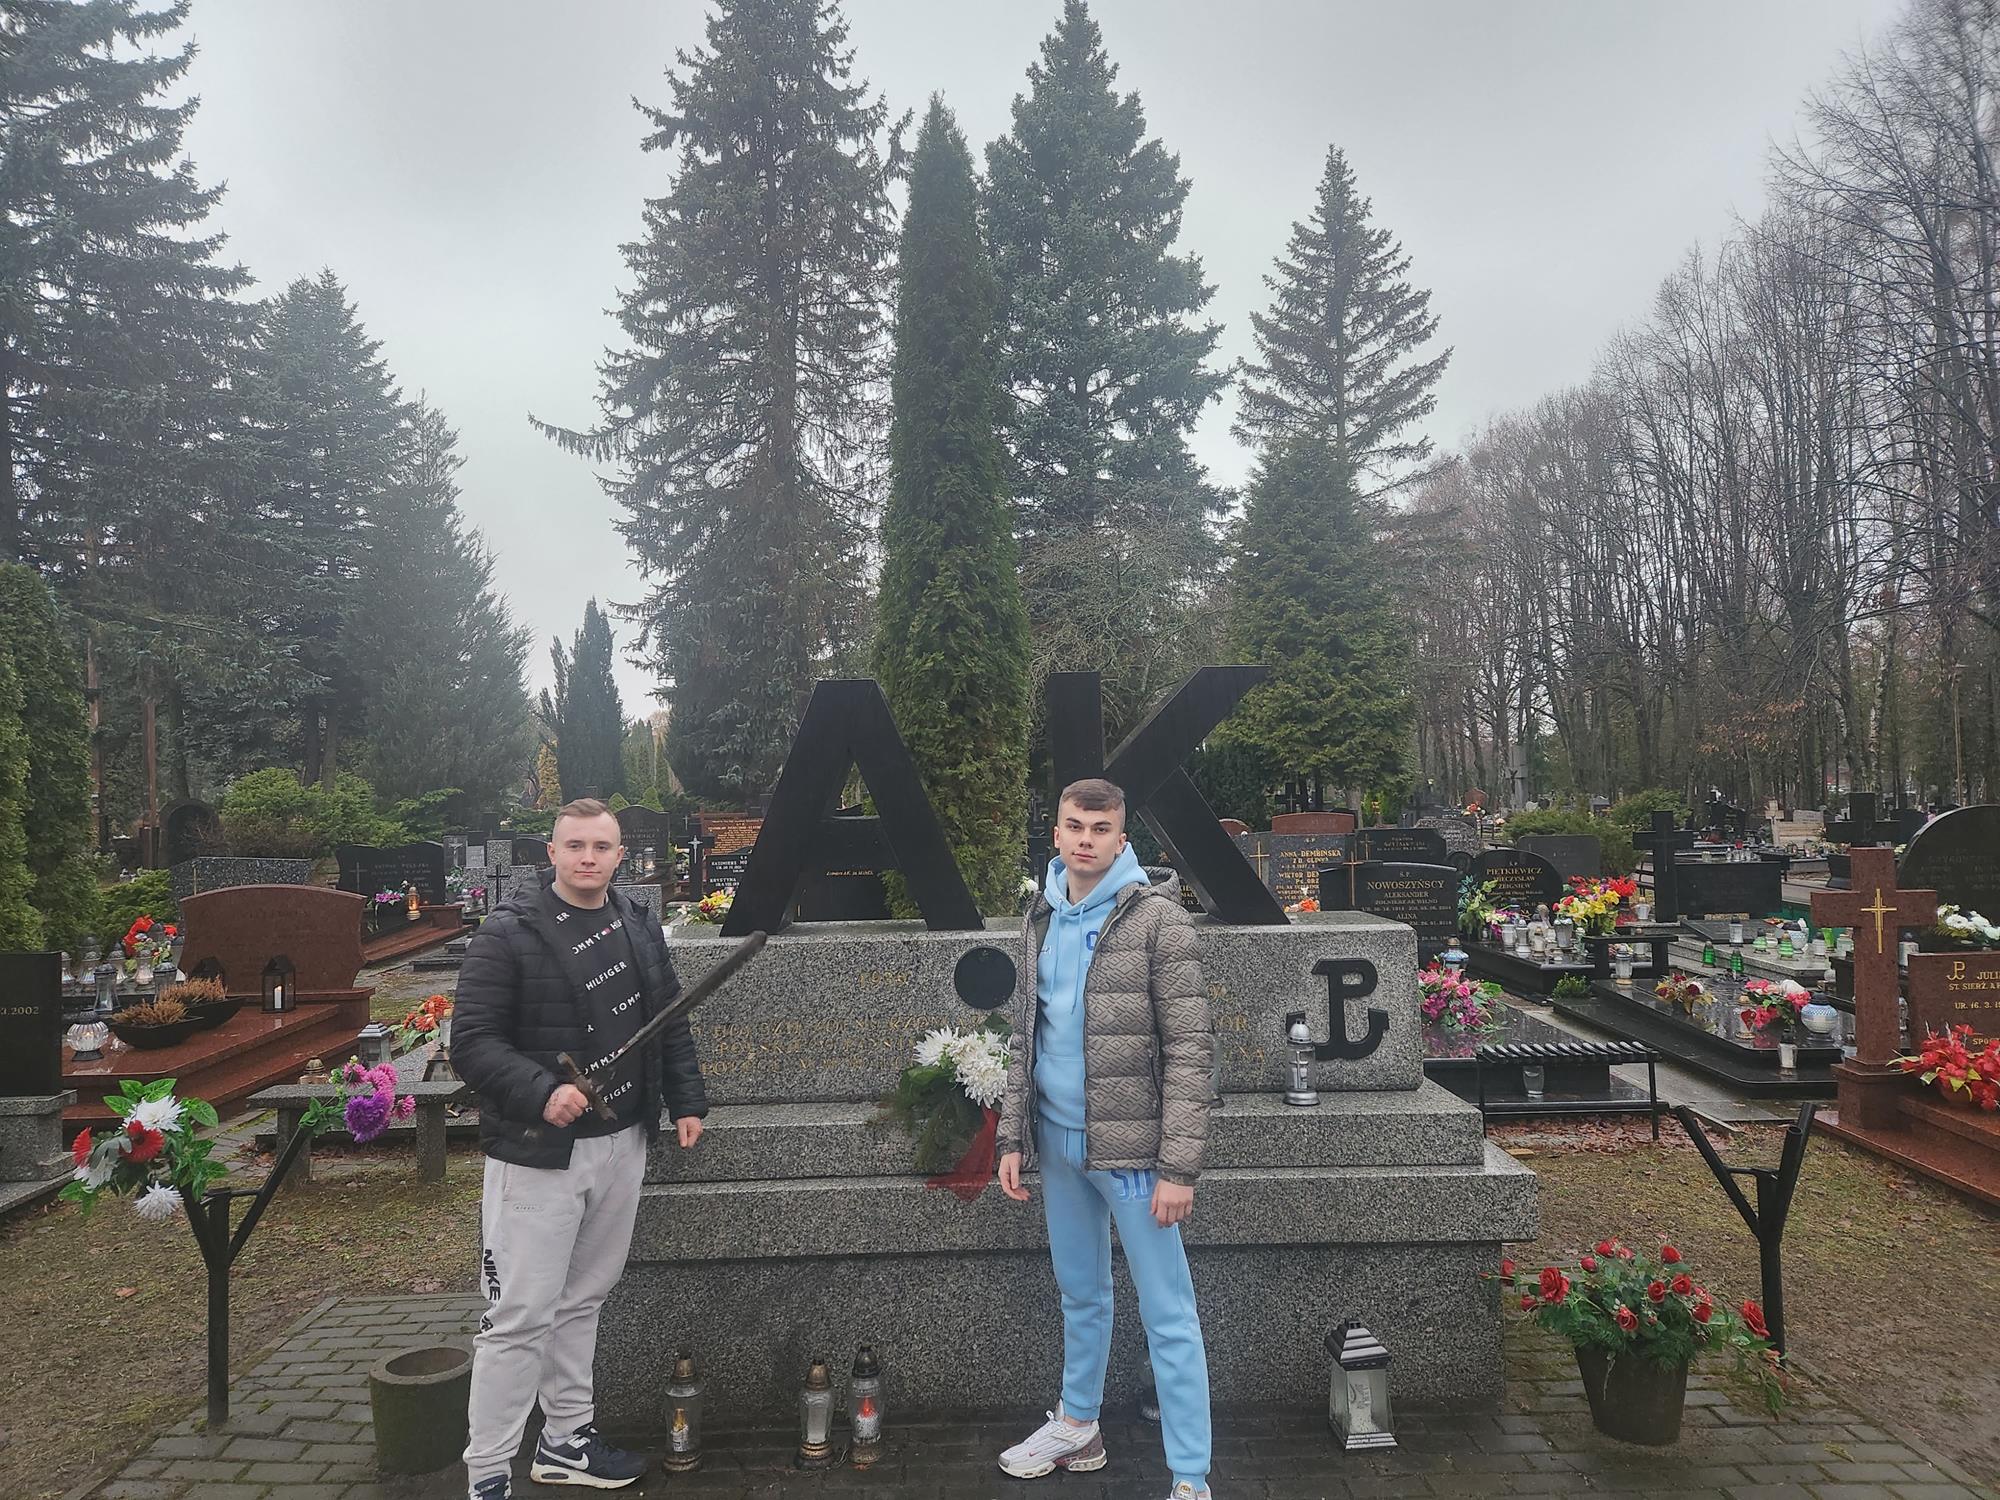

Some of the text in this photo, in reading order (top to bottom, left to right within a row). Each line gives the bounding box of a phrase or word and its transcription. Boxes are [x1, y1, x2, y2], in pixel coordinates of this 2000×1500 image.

[1367, 879, 1445, 890] NOWOSZYŃSCY
[1384, 890, 1429, 898] ALEKSANDER
[585, 961, 627, 991] HILFIGER
[483, 1248, 501, 1301] NIKE
